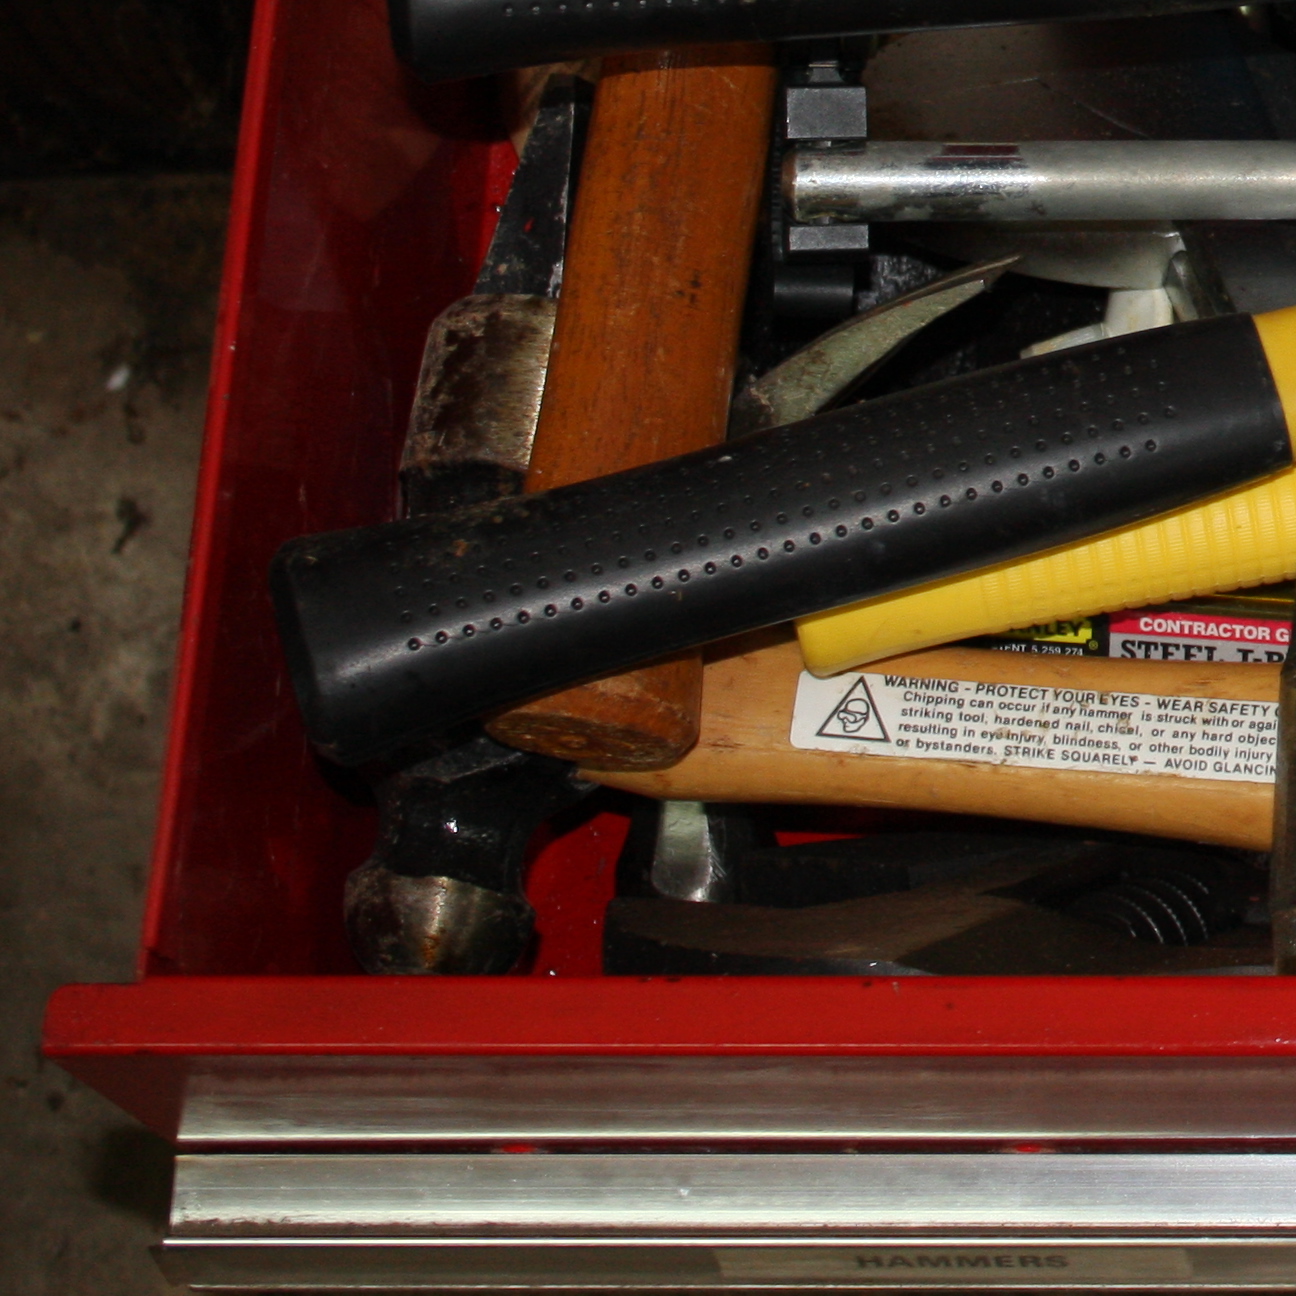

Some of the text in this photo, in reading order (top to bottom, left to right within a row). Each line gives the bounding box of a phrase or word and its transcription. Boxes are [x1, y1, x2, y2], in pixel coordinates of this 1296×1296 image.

[1139, 617, 1274, 641] CONTRACTOR
[885, 675, 960, 693] WARNING
[976, 683, 1049, 701] PROTECT
[1053, 690, 1096, 704] YOUR
[1099, 693, 1140, 708] EYES
[1157, 698, 1204, 713] WEAR
[1208, 701, 1271, 718] SAFETY
[903, 690, 1277, 733] Chipping can occur if any hammer is struck with or agai
[898, 721, 1274, 763] resulting in eye injury, blindness, or other bodily injury
[901, 706, 1277, 747] striking tool, hardened nail, chisel, or any hard objec
[896, 738, 911, 748] or
[916, 738, 998, 756] bystanders.
[1003, 745, 1057, 760] STRIKE
[1061, 750, 1139, 767] SQUARELY
[1164, 757, 1209, 772] AVOID
[857, 1254, 1069, 1269] HAMMERS
